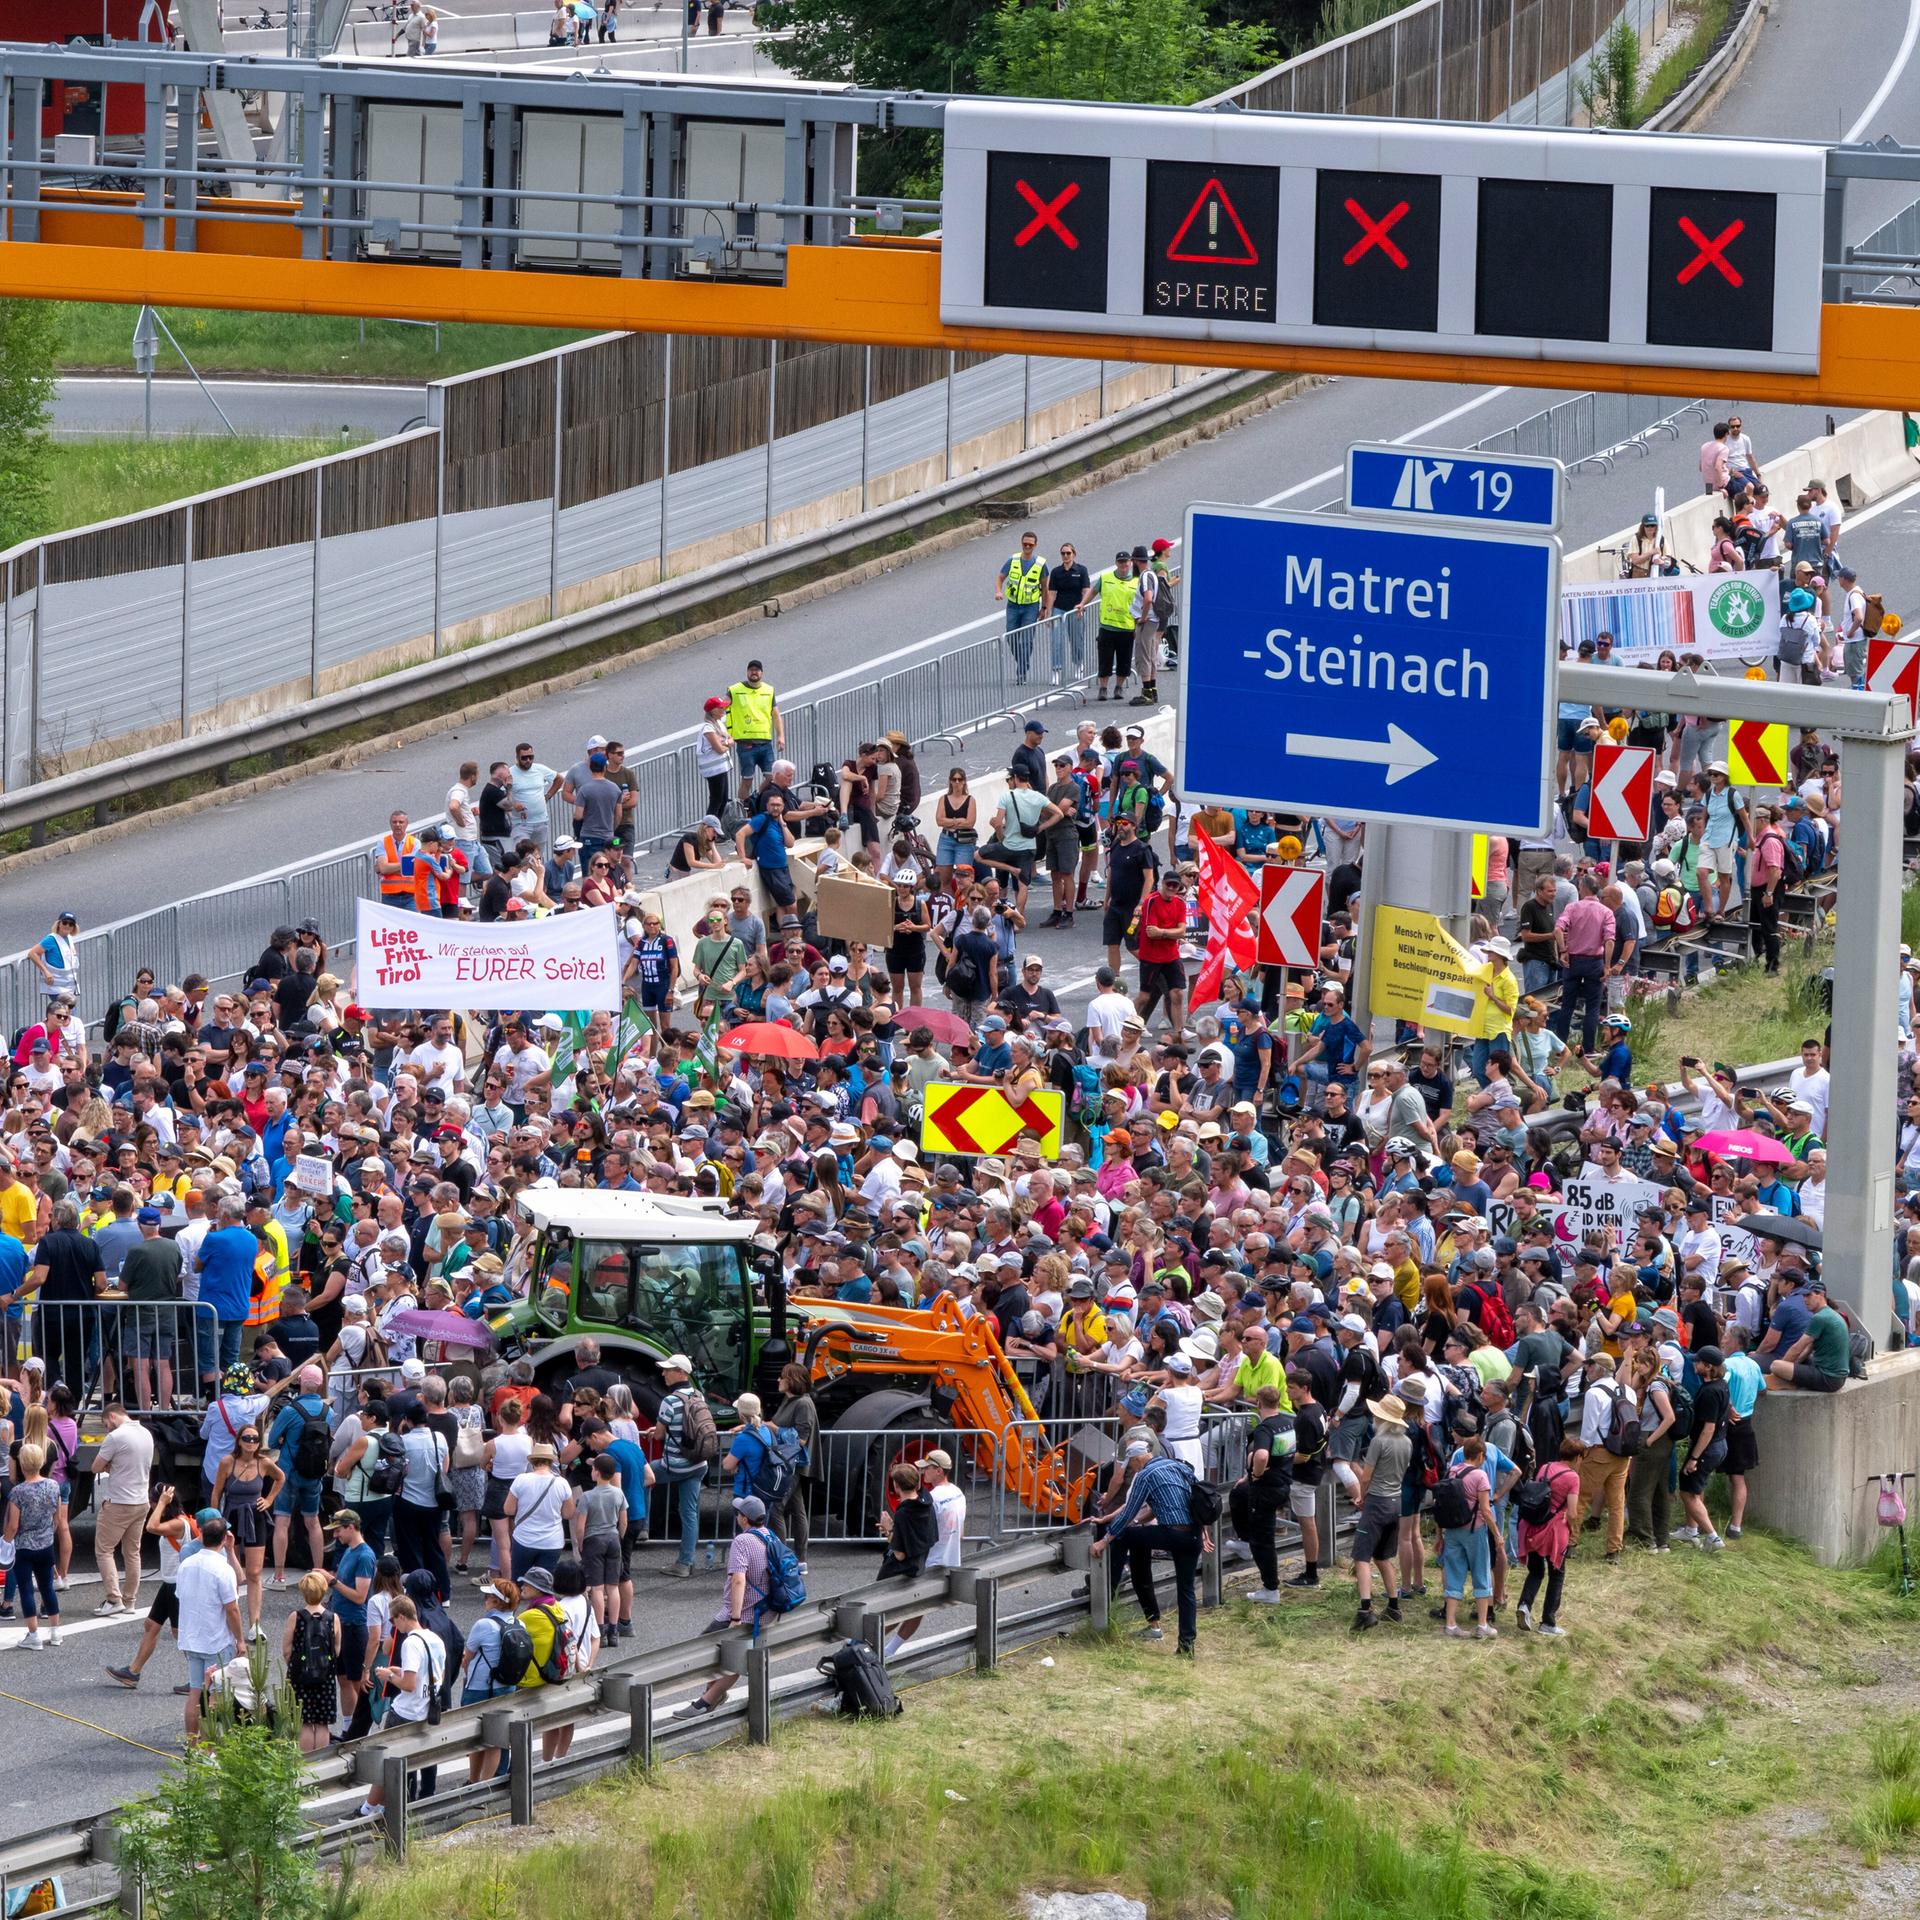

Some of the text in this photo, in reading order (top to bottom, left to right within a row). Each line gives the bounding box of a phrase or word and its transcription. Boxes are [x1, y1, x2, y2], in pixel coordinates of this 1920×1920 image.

[1157, 281, 1268, 312] SPERRE
[1469, 470, 1513, 512] 19
[1285, 555, 1451, 620] Matrei
[1561, 590, 1582, 598] AKTEN
[1709, 581, 1763, 610] TEACHERS FOR FUTURE
[1243, 628, 1490, 700] -Steinach
[370, 928, 418, 948] Liste
[1394, 925, 1422, 941] Mensch
[384, 946, 433, 965] Fritz.
[438, 943, 529, 957] Wir stehen auf
[1398, 943, 1416, 956] NEIN
[375, 964, 421, 986] Tirol
[456, 956, 606, 981] EURER Seite!
[731, 1036, 746, 1046] IN
[1728, 1144, 1753, 1154] NEOS
[1567, 1184, 1615, 1210] 85 dB
[853, 1343, 878, 1353] CARGO
